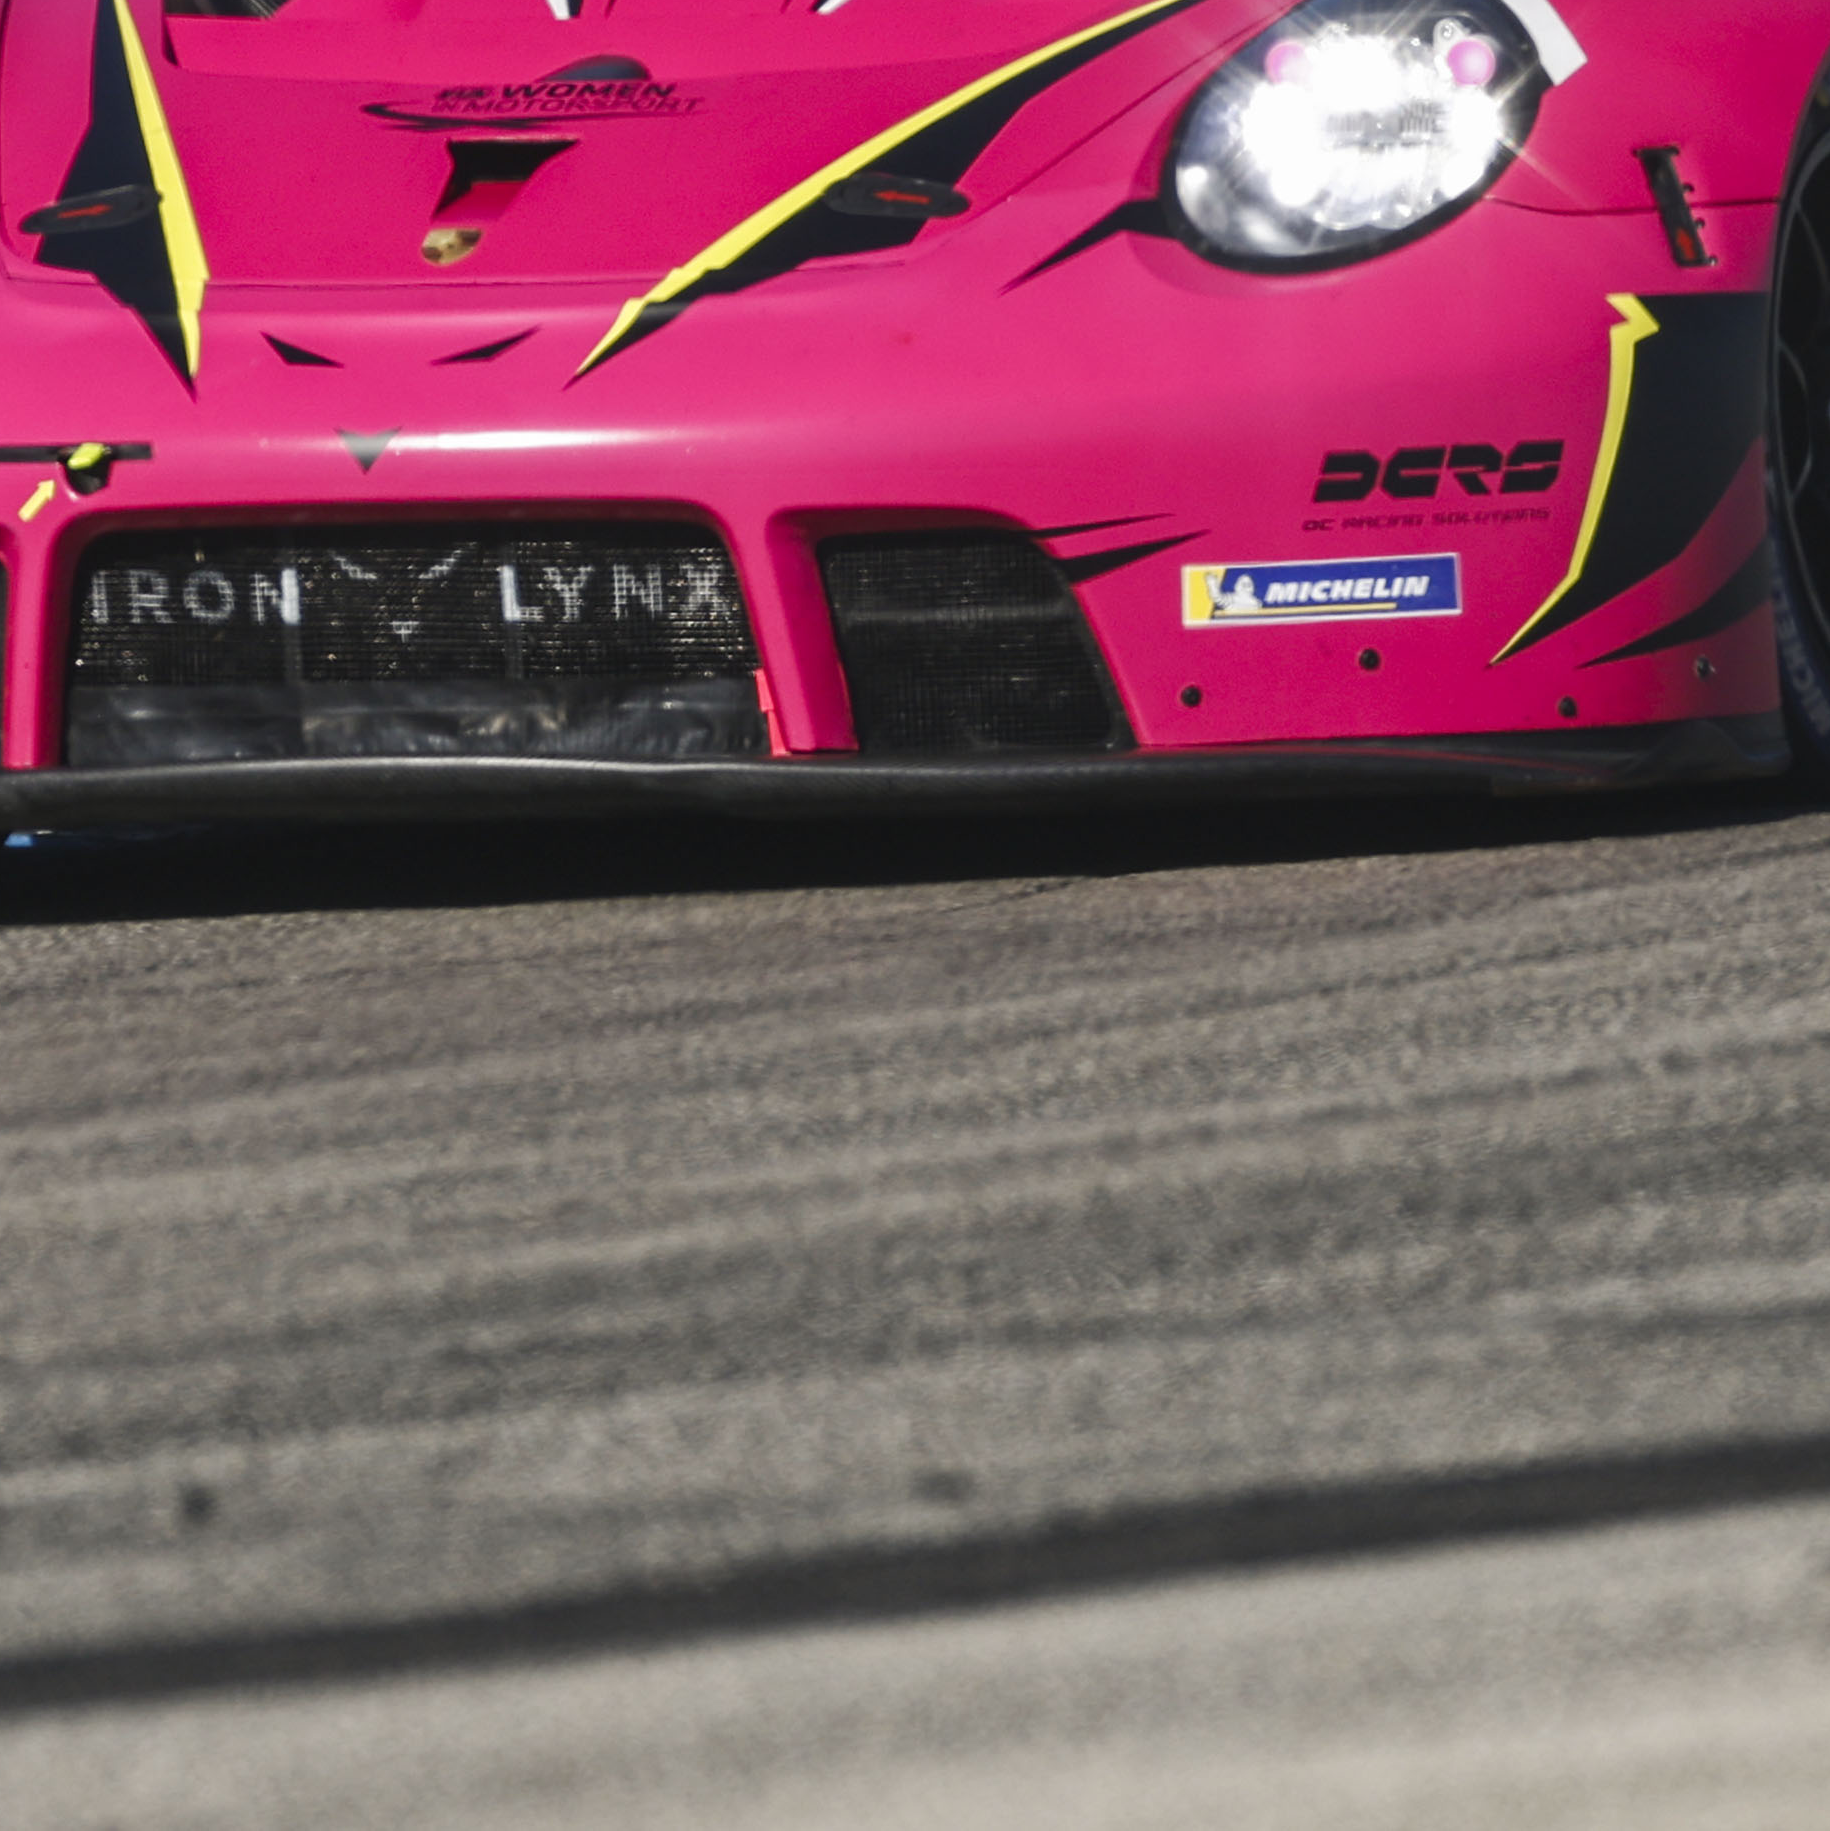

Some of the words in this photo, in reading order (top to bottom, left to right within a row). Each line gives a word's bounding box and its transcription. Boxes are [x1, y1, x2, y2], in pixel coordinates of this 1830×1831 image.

[502, 82, 677, 99] WOMEN
[463, 96, 707, 114] MOTORSPORT
[91, 566, 301, 626] IRON
[497, 563, 731, 624] LYNX
[1264, 574, 1431, 604] MICHELIN
